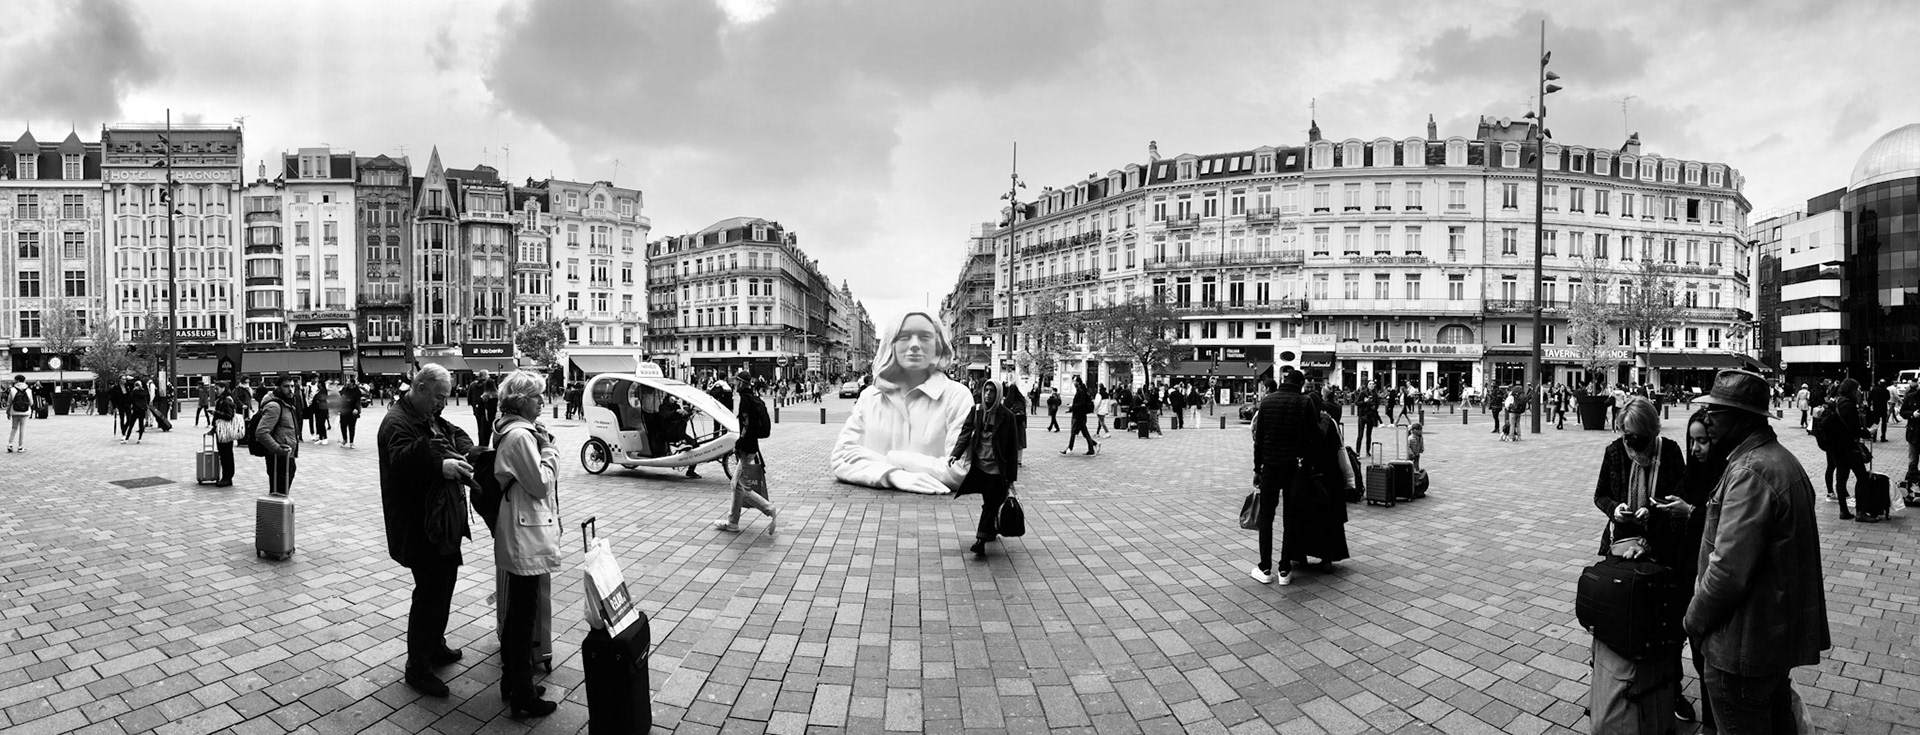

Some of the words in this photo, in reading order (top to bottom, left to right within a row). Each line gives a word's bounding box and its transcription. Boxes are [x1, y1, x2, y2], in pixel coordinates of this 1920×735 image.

[111, 170, 156, 180] HOTEL
[1350, 256, 1375, 264] HOTEL
[174, 329, 216, 338] RASSEURS
[1361, 345, 1372, 353] LE
[1373, 345, 1403, 354] PALAIS
[1406, 345, 1418, 353] DE
[1420, 345, 1431, 354] LA
[1543, 349, 1581, 358] TAVERNE
